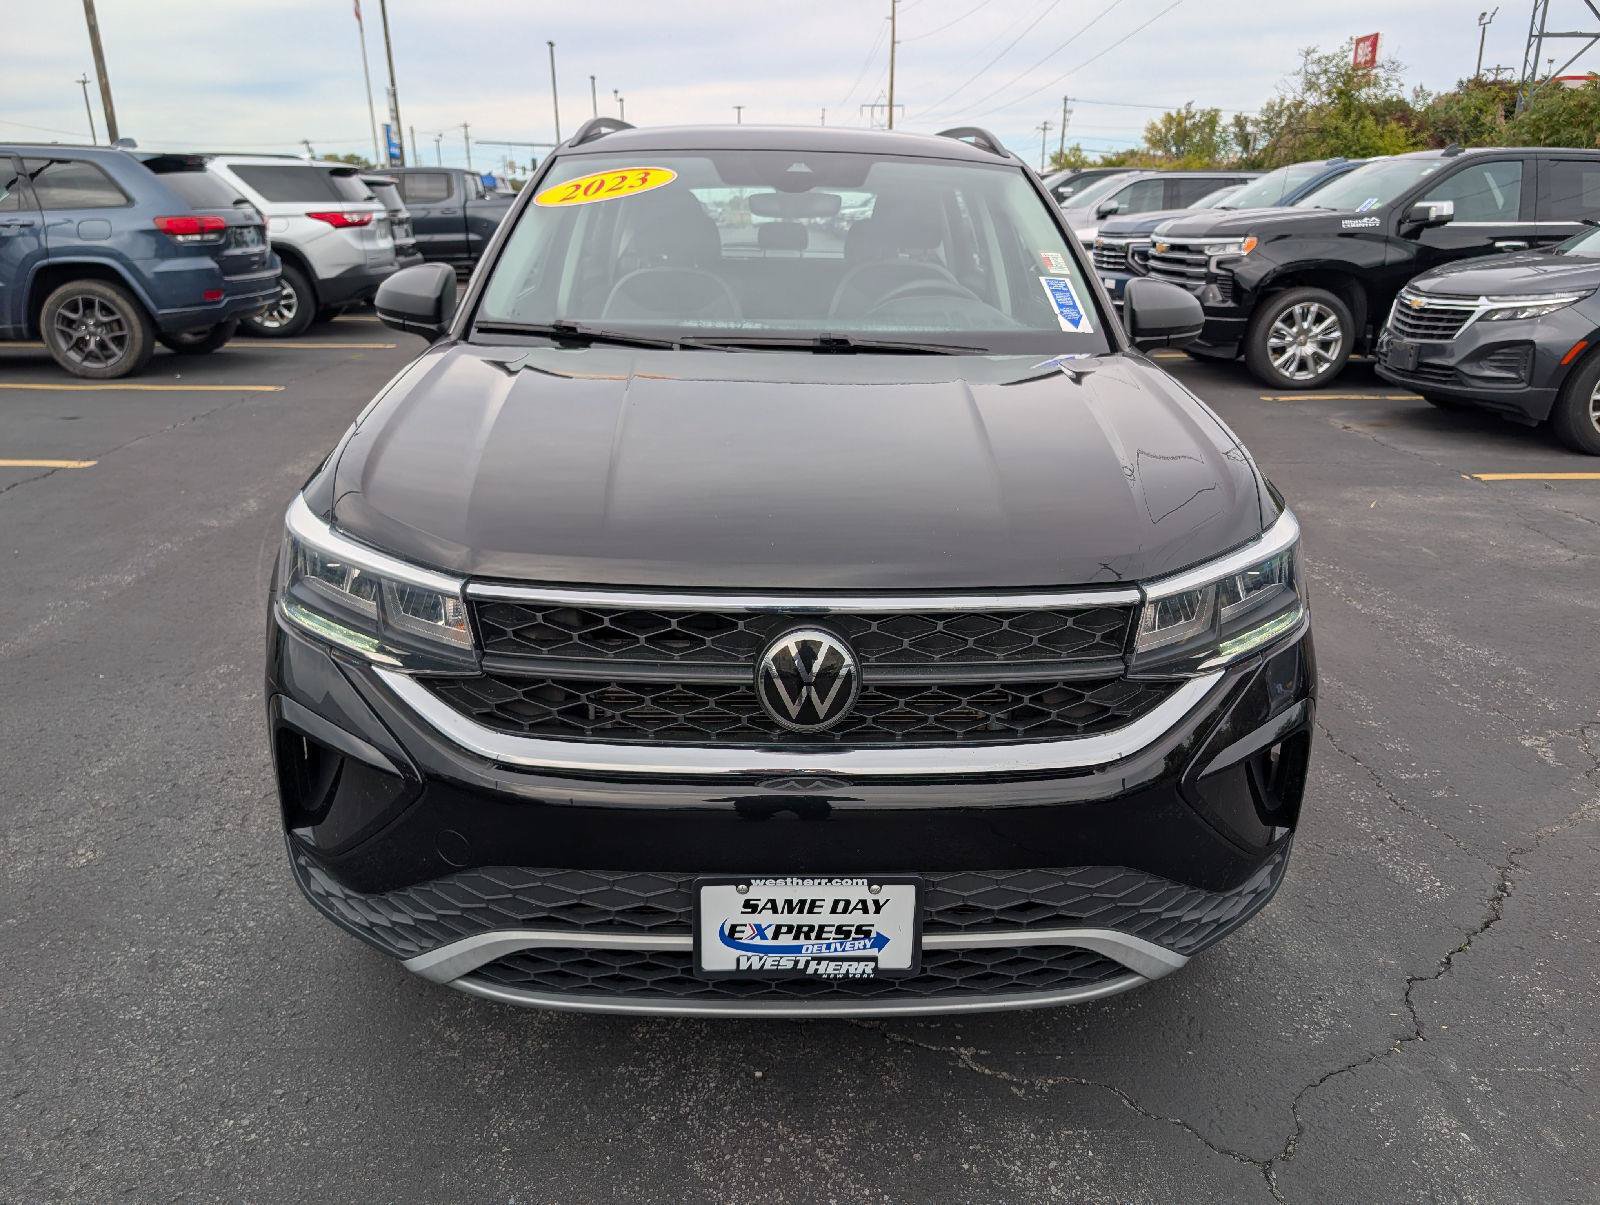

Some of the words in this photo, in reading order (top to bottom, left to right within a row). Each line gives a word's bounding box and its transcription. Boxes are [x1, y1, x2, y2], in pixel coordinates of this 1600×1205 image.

[559, 172, 651, 202] 2023
[750, 877, 868, 886] westherr.com
[740, 898, 826, 915] SAME
[829, 898, 891, 915] DAY
[726, 923, 875, 941] EXPRESS
[801, 938, 874, 954] DELIVERY
